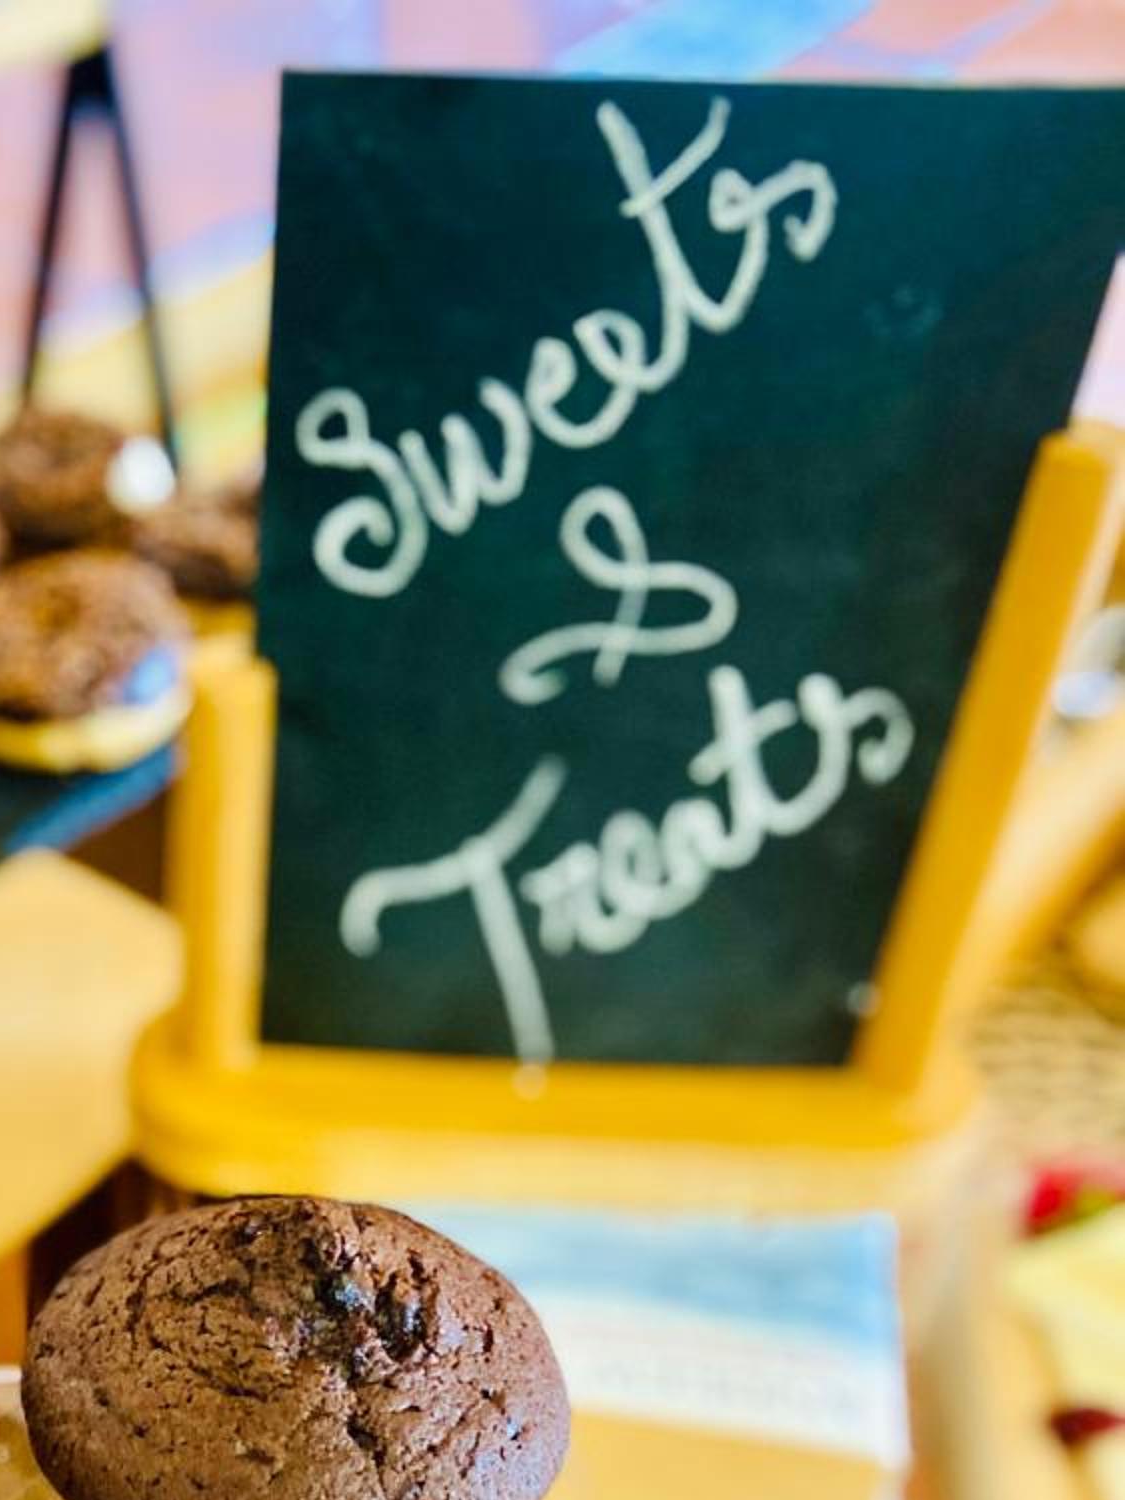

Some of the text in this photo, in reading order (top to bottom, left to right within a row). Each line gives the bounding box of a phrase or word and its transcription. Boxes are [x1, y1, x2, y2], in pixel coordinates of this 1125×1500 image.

[296, 97, 838, 598] Sweets
[499, 485, 739, 706] &
[339, 664, 914, 1090] Treats
